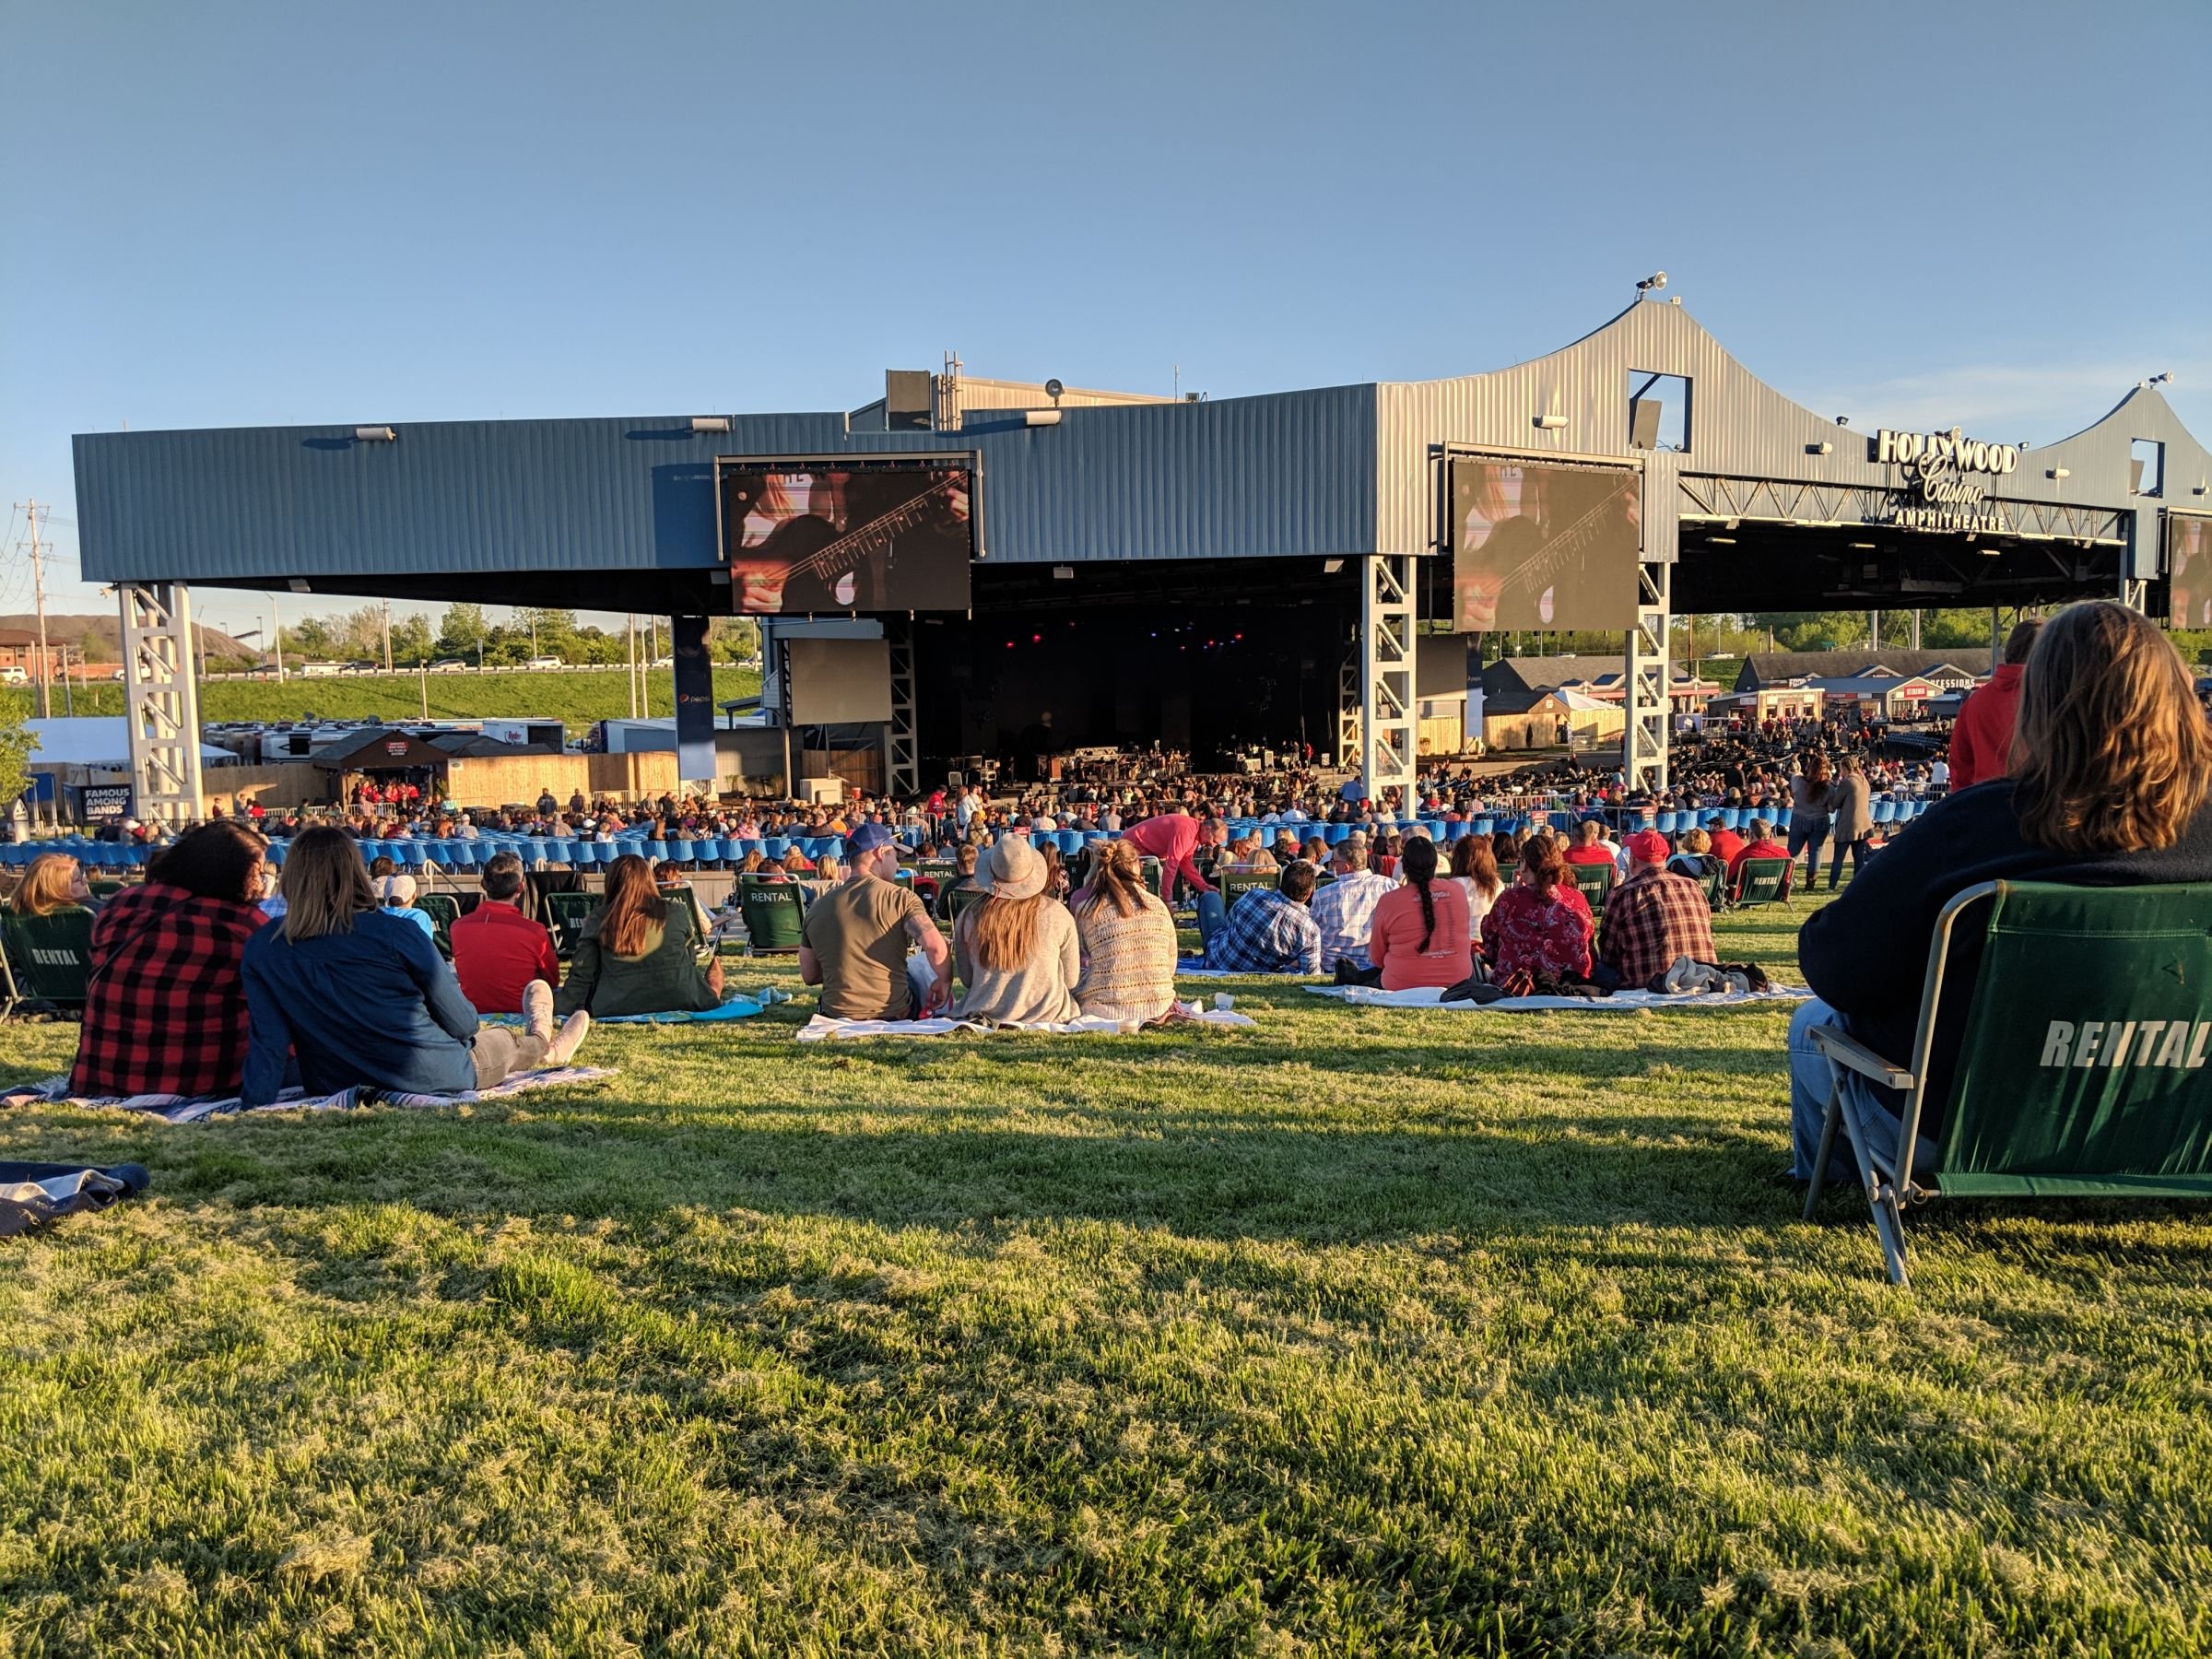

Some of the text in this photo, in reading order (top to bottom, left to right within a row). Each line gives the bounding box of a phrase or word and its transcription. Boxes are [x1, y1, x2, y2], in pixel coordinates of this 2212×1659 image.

[1878, 429, 2018, 474] HOLLYWOOD
[1919, 453, 1984, 505] Casino
[1895, 510, 2006, 532] AMPHITHEATRE
[690, 694, 710, 704] pepsi
[86, 789, 130, 798] FAMOUS
[86, 797, 126, 806] AMONG
[87, 806, 124, 815] BANDS
[924, 870, 955, 878] RENTAL
[1230, 881, 1272, 892] RENTAL
[1577, 881, 1602, 891] RENTAL
[1753, 877, 1778, 886] RENTAL
[751, 892, 793, 902] RENTAL
[31, 947, 80, 966] RENTAL
[2039, 1019, 2212, 1069] RENTAL
